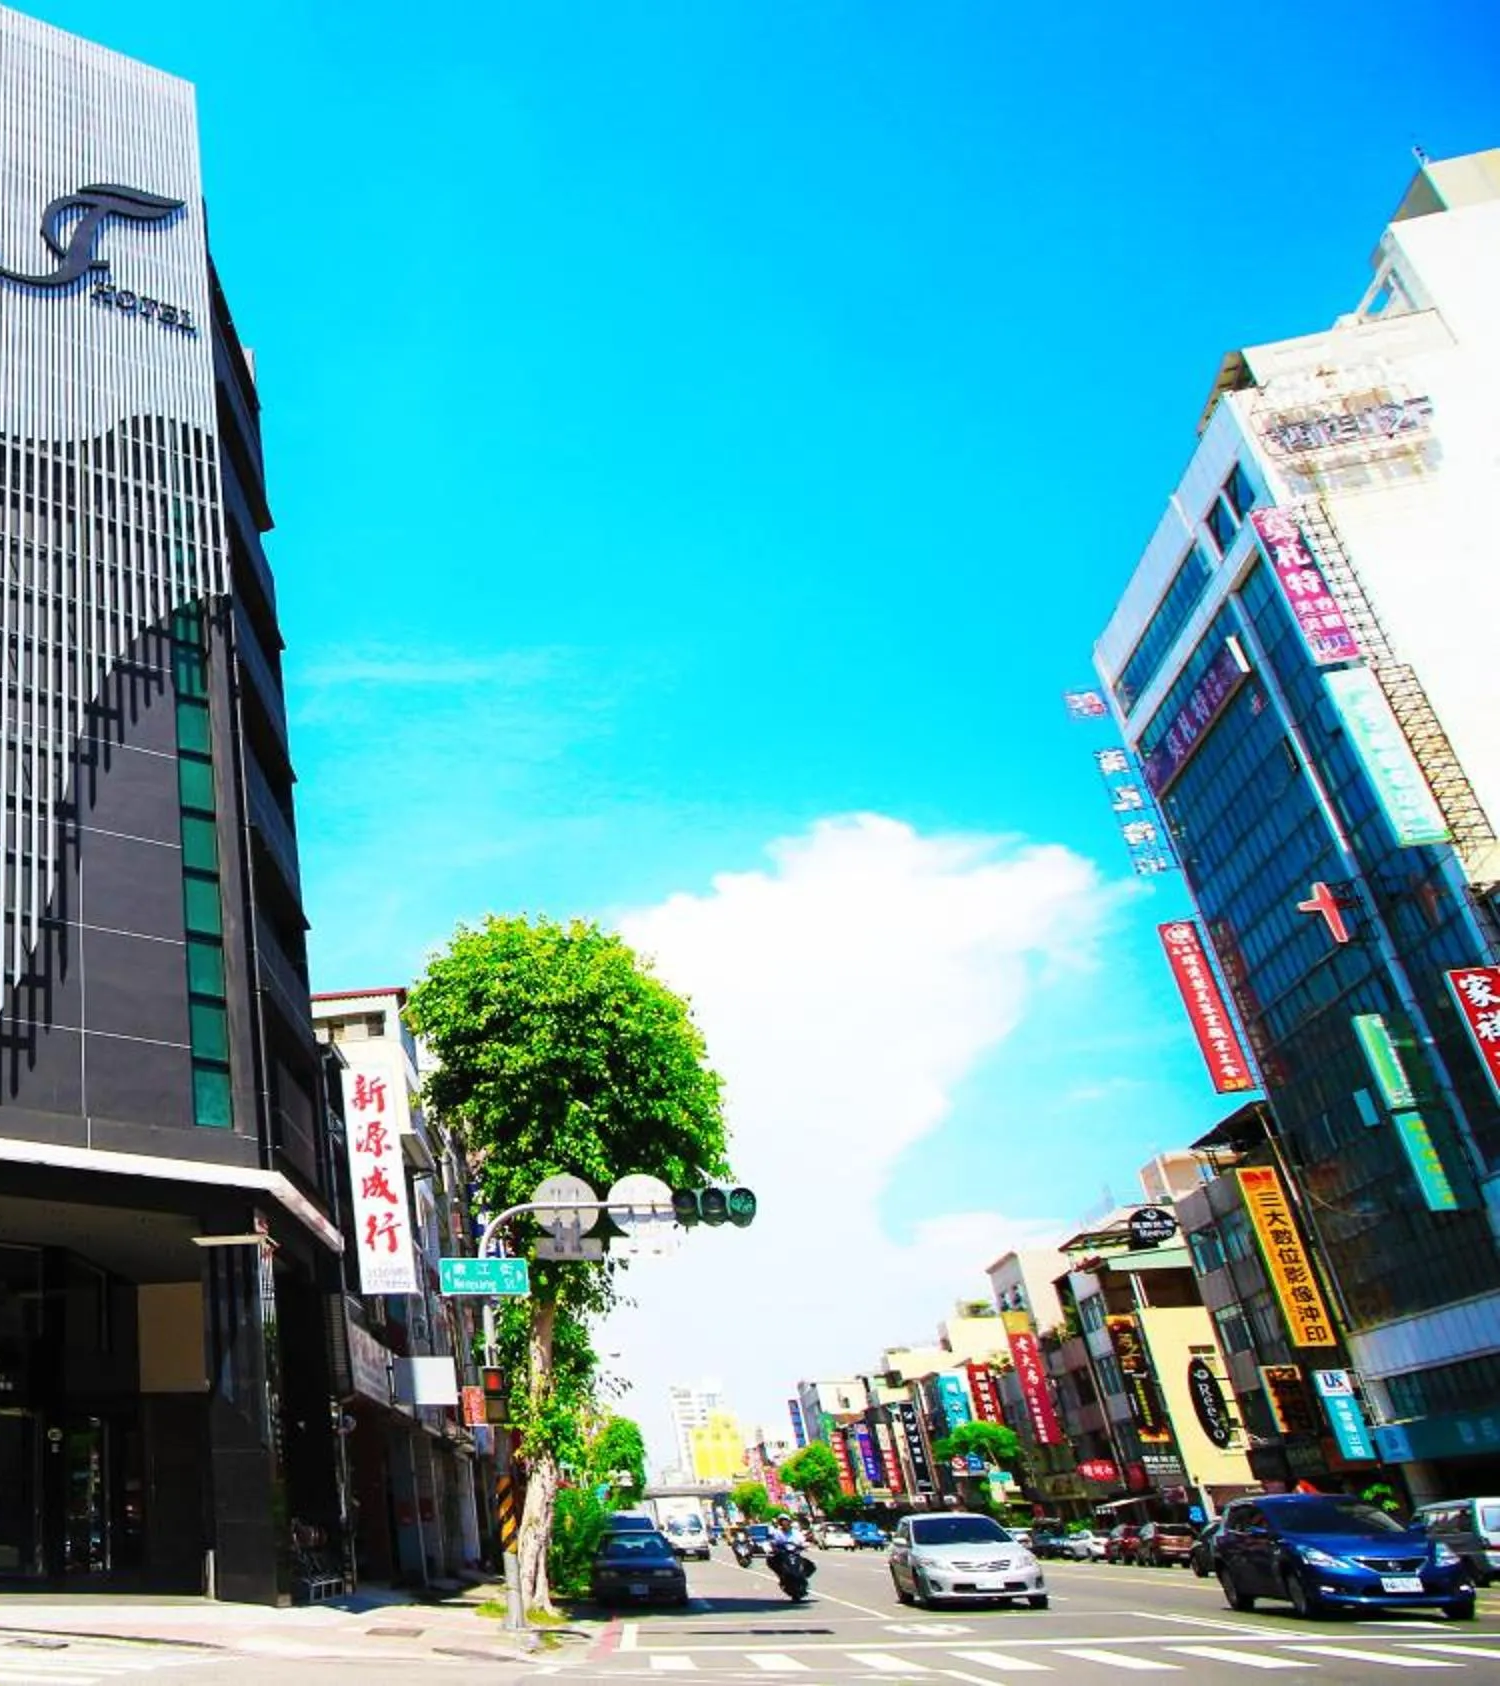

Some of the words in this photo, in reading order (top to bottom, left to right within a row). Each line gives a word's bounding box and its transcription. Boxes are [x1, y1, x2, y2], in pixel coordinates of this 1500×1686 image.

[90, 280, 197, 333] HOTEL
[351, 1073, 402, 1254] 新源成行
[1256, 1190, 1329, 1343] 三大數位影像沖印
